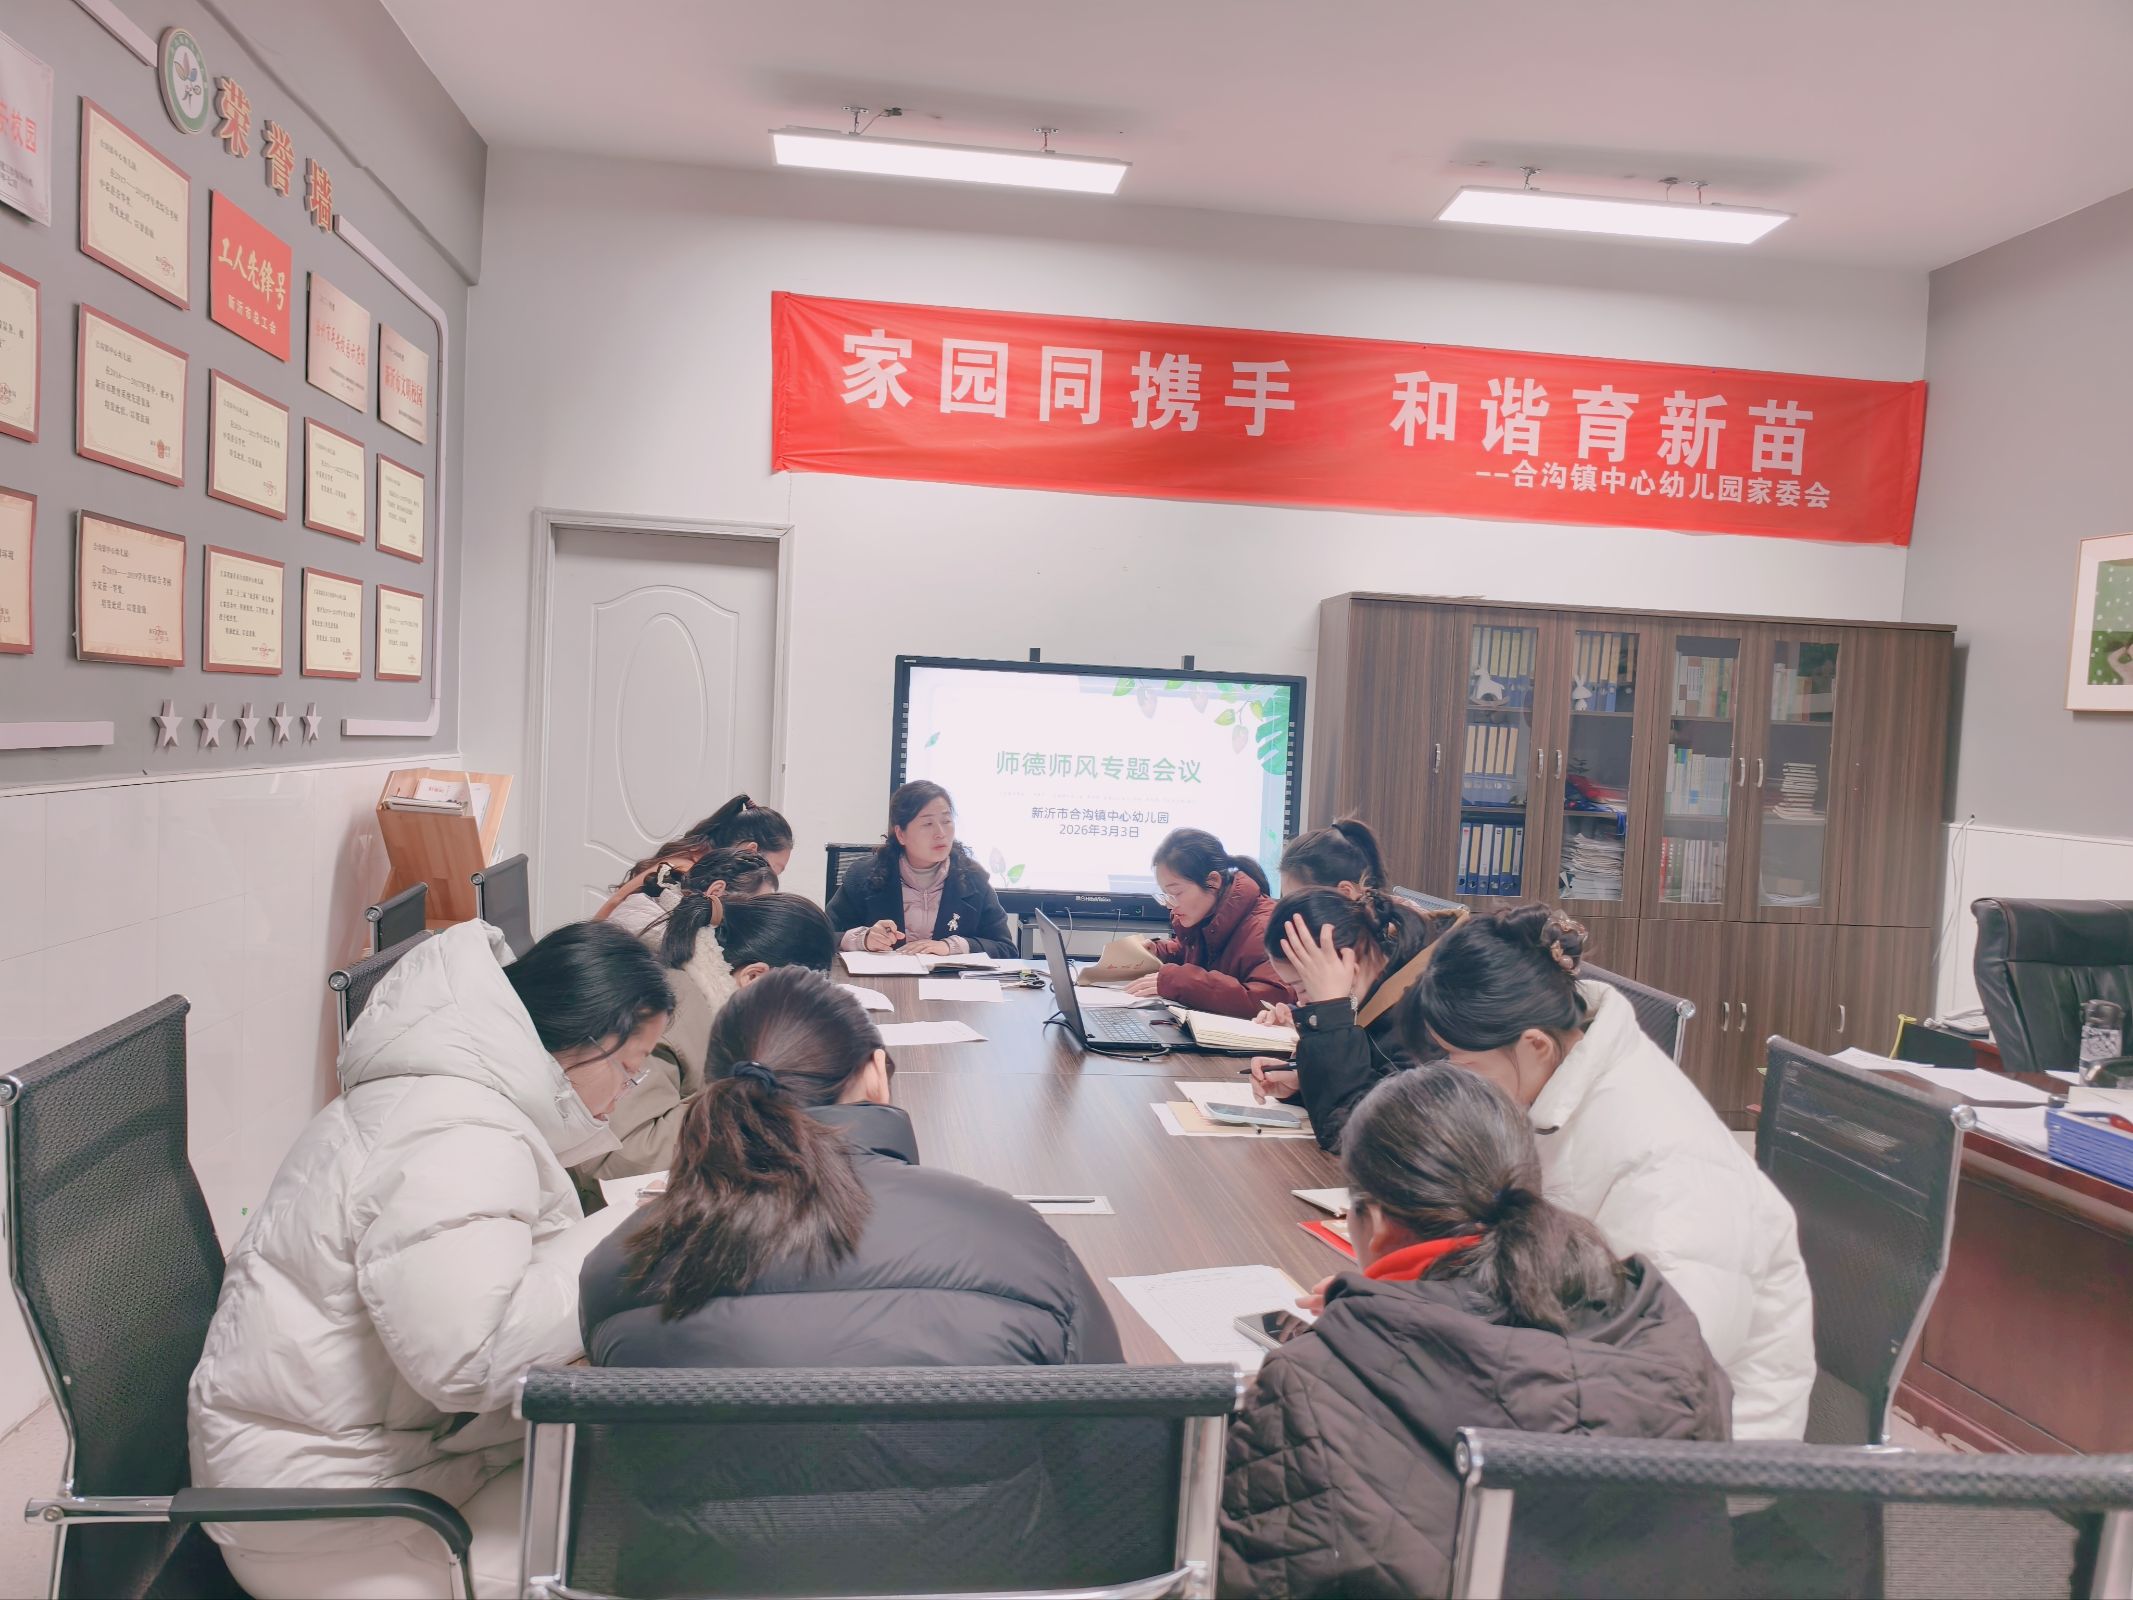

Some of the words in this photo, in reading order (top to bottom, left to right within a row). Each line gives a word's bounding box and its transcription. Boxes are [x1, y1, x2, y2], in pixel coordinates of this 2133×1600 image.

[213, 76, 333, 233] 荣誉墙
[218, 237, 287, 312] 工人先锋号
[842, 329, 1296, 437] 家园同携手
[1389, 370, 1815, 477] 和谐育新苗
[996, 750, 1202, 784] 师德师风专题会议
[1031, 806, 1169, 824] 新沂市合沟镇中心幼儿园
[1059, 824, 1140, 838] 2026年3月3日
